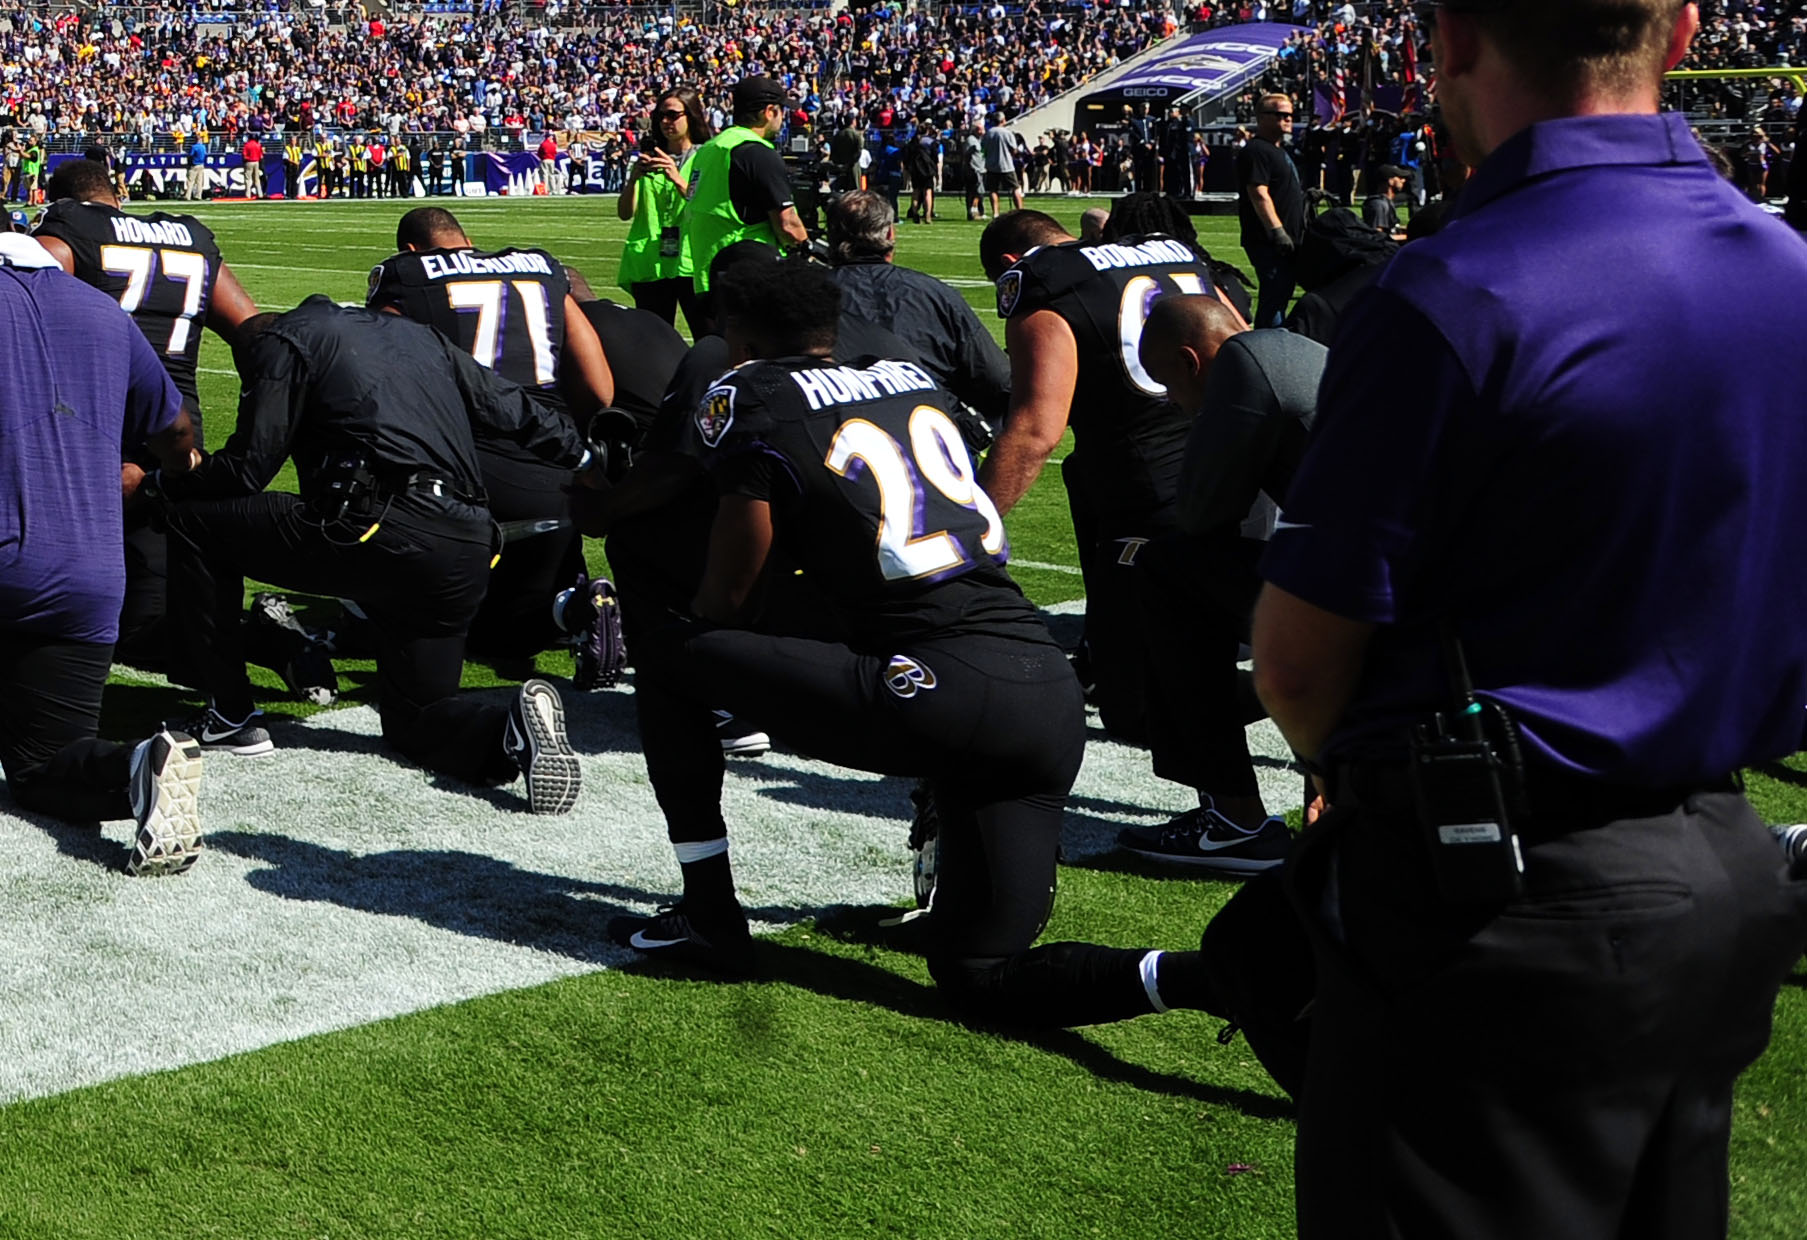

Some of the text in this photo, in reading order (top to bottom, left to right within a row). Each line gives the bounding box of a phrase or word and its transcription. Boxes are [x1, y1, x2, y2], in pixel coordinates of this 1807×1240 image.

[1123, 87, 1168, 97] GEICO
[126, 157, 226, 165] BALTIMRE
[100, 244, 206, 354] 77
[447, 280, 559, 387] 71
[824, 404, 1008, 582] 29
